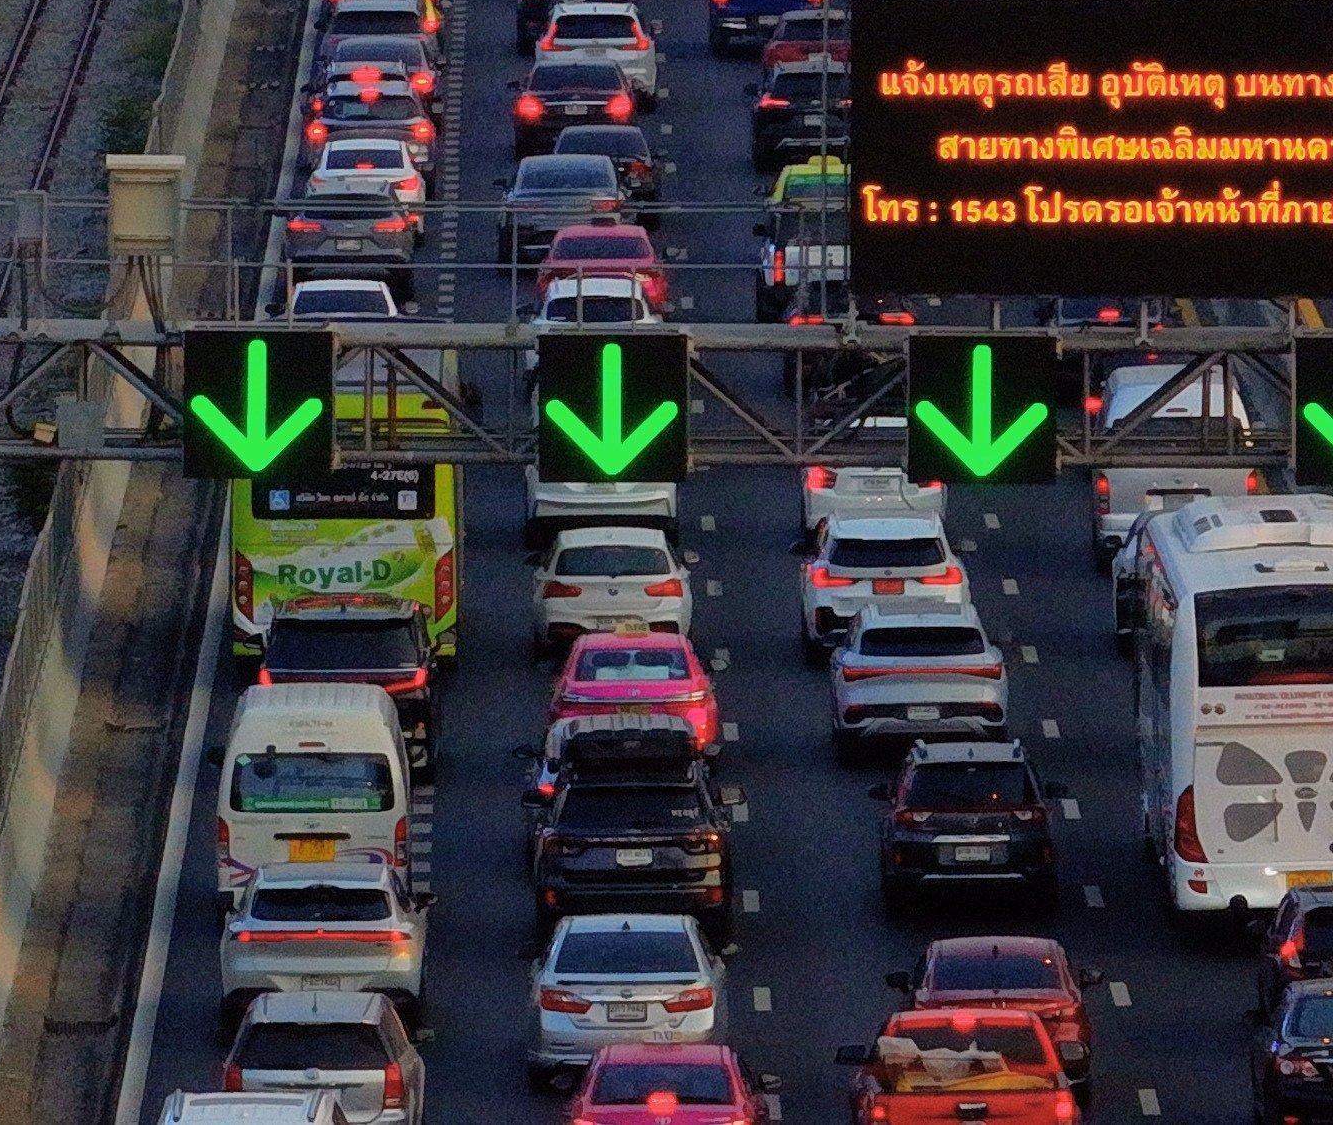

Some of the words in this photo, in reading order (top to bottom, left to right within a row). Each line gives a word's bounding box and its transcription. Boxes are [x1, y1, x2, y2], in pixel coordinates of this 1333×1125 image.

[880, 60, 1090, 109] แจ้งเหตุรถเสีย
[1100, 61, 1225, 110] อุบัติเหตุ
[938, 126, 1333, 161] สายทางพิเศษเฉลิมมหานค
[861, 184, 919, 223] โทร
[950, 200, 1016, 223] 1543
[278, 558, 392, 590] Royal-D
